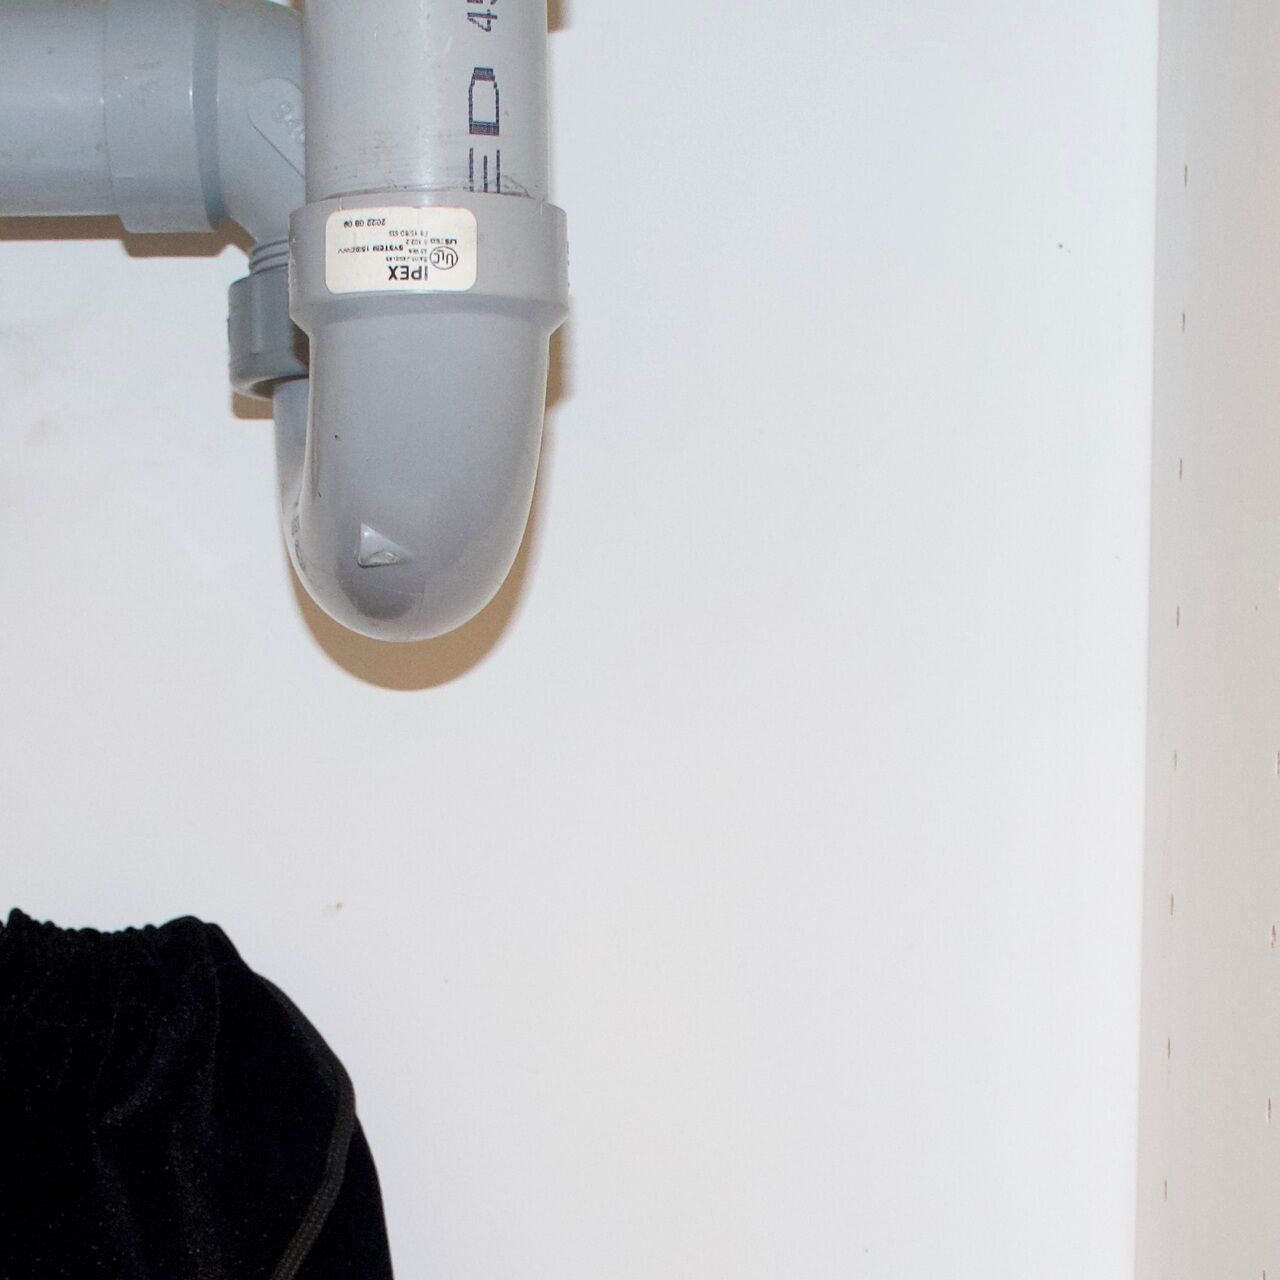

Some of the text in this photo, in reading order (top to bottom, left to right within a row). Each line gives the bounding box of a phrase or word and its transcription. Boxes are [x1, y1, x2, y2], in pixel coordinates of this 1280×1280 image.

[367, 218, 386, 227] 2022
[433, 250, 454, 265] ULC
[388, 265, 429, 281] IPEX
